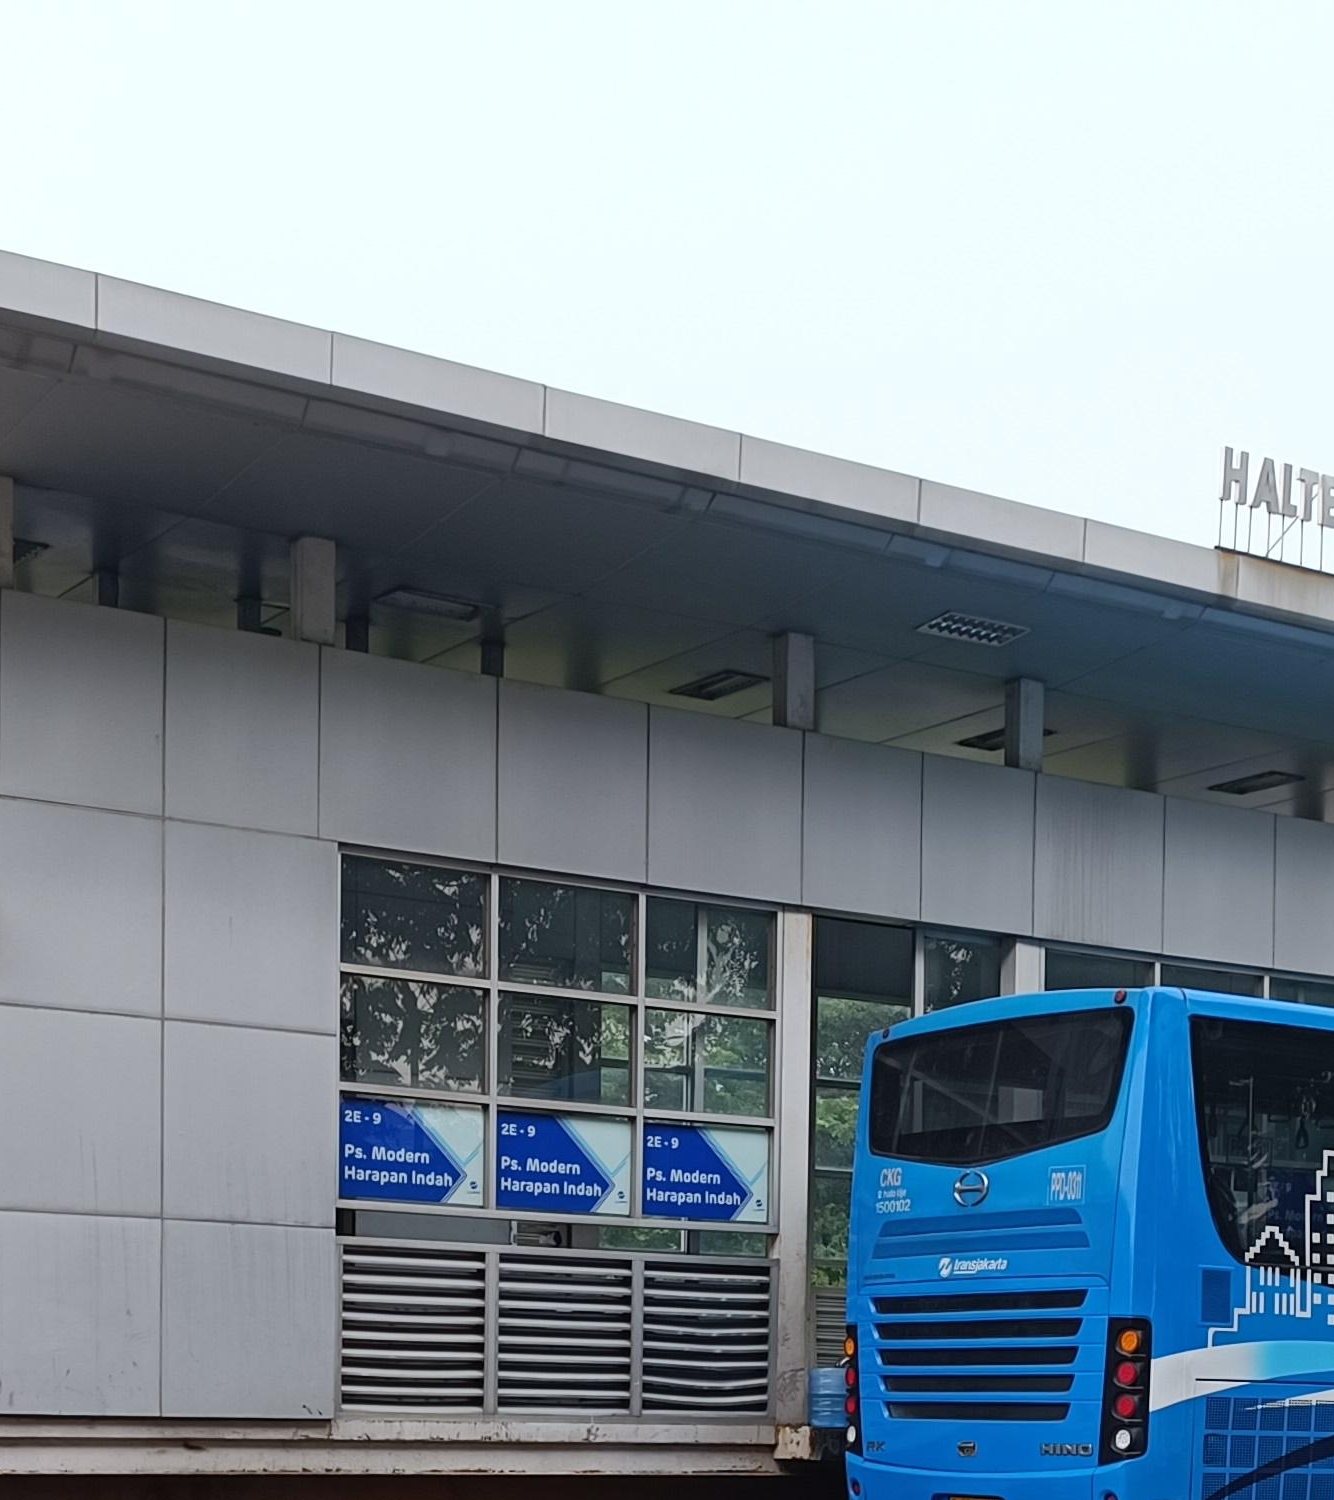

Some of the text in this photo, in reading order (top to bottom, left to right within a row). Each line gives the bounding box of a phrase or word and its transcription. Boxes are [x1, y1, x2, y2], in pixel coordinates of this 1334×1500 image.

[344, 1110, 361, 1123] 2E
[373, 1112, 382, 1124] 9
[501, 1123, 517, 1136] 2E
[527, 1125, 536, 1137] 9
[647, 1136, 662, 1148] 2E
[671, 1137, 679, 1149] 9
[344, 1144, 430, 1164] Ps. Modern
[501, 1156, 581, 1175] Ps. Modern
[344, 1166, 452, 1187] Harapan Indah
[646, 1167, 721, 1184] Ps. Modern
[880, 1167, 902, 1187] CKG
[500, 1177, 602, 1197] Harapan Indah
[646, 1188, 741, 1206] Harapan Indah
[875, 1199, 911, 1214] 1500102
[953, 1258, 1007, 1274] transjakarta
[1040, 1443, 1093, 1457] HINO
